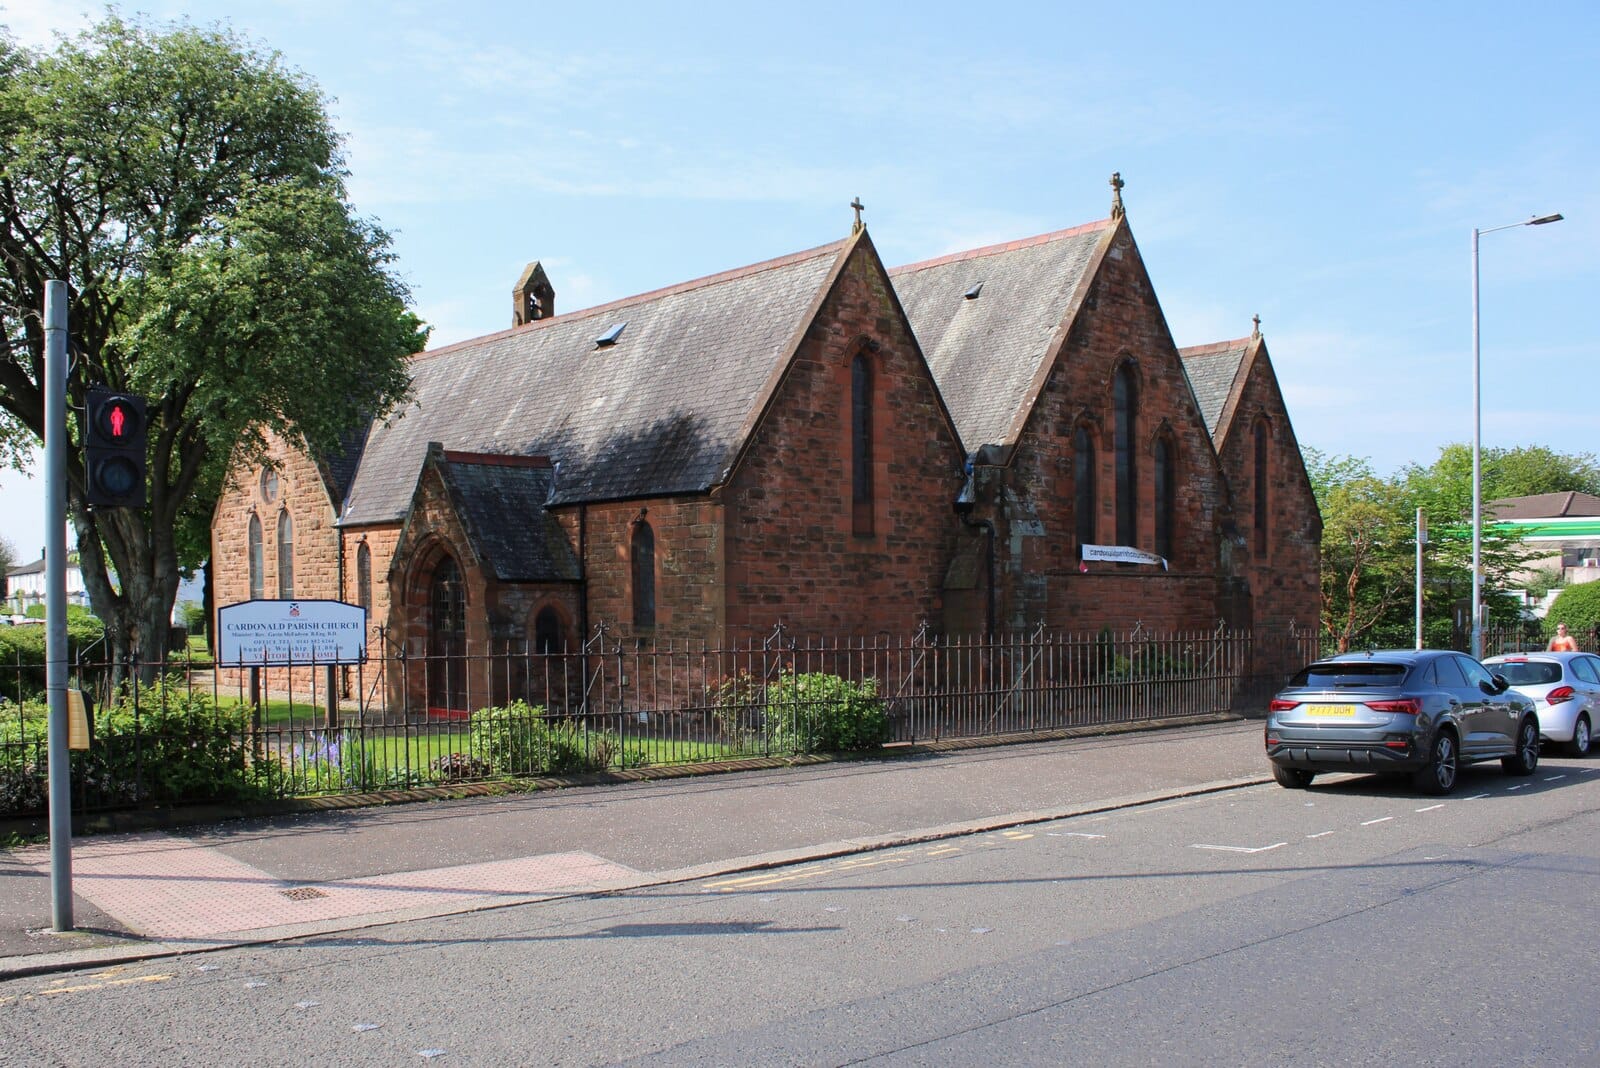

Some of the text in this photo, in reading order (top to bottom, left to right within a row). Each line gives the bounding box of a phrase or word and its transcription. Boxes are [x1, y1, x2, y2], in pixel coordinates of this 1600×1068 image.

[226, 622, 358, 631] CARDONALD PARISH CHURCH
